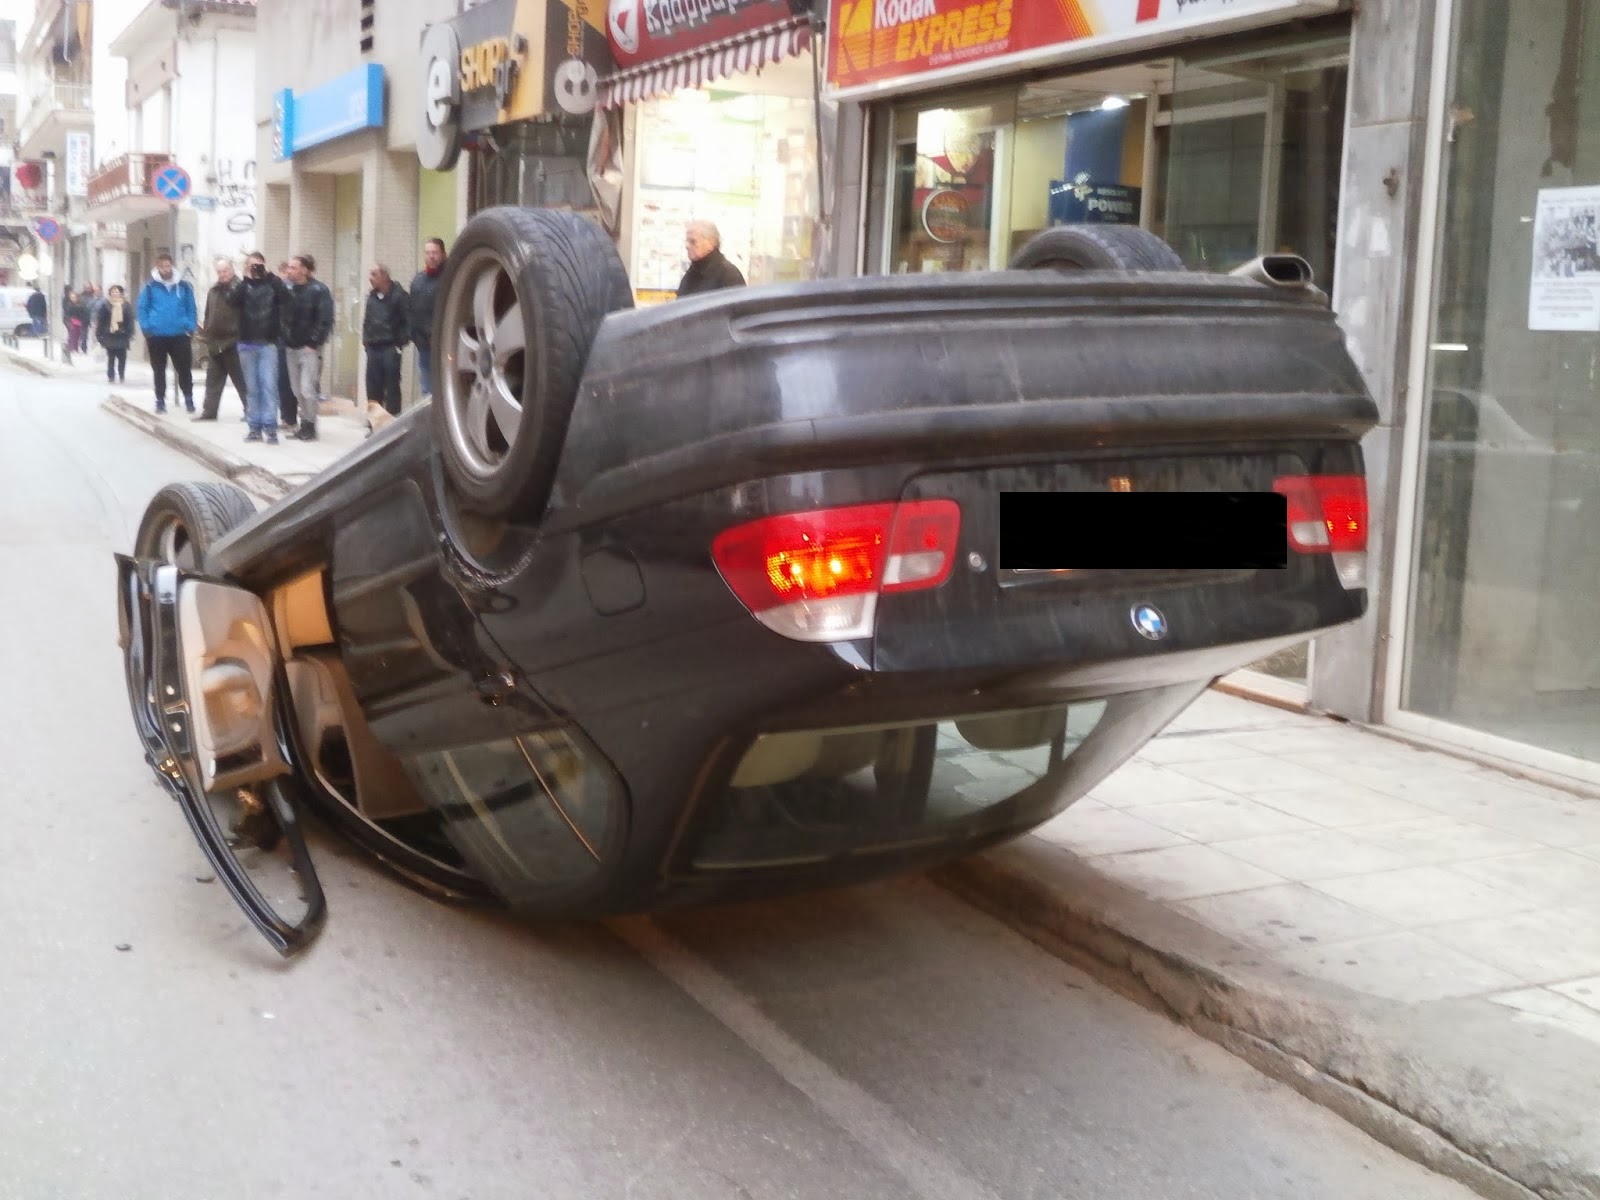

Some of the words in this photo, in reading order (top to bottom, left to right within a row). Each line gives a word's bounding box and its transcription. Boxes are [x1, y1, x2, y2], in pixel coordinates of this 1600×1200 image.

[895, 0, 1013, 62] EXPRESS
[427, 60, 452, 127] e
[460, 37, 509, 92] SHOP
[1088, 199, 1133, 214] POWER
